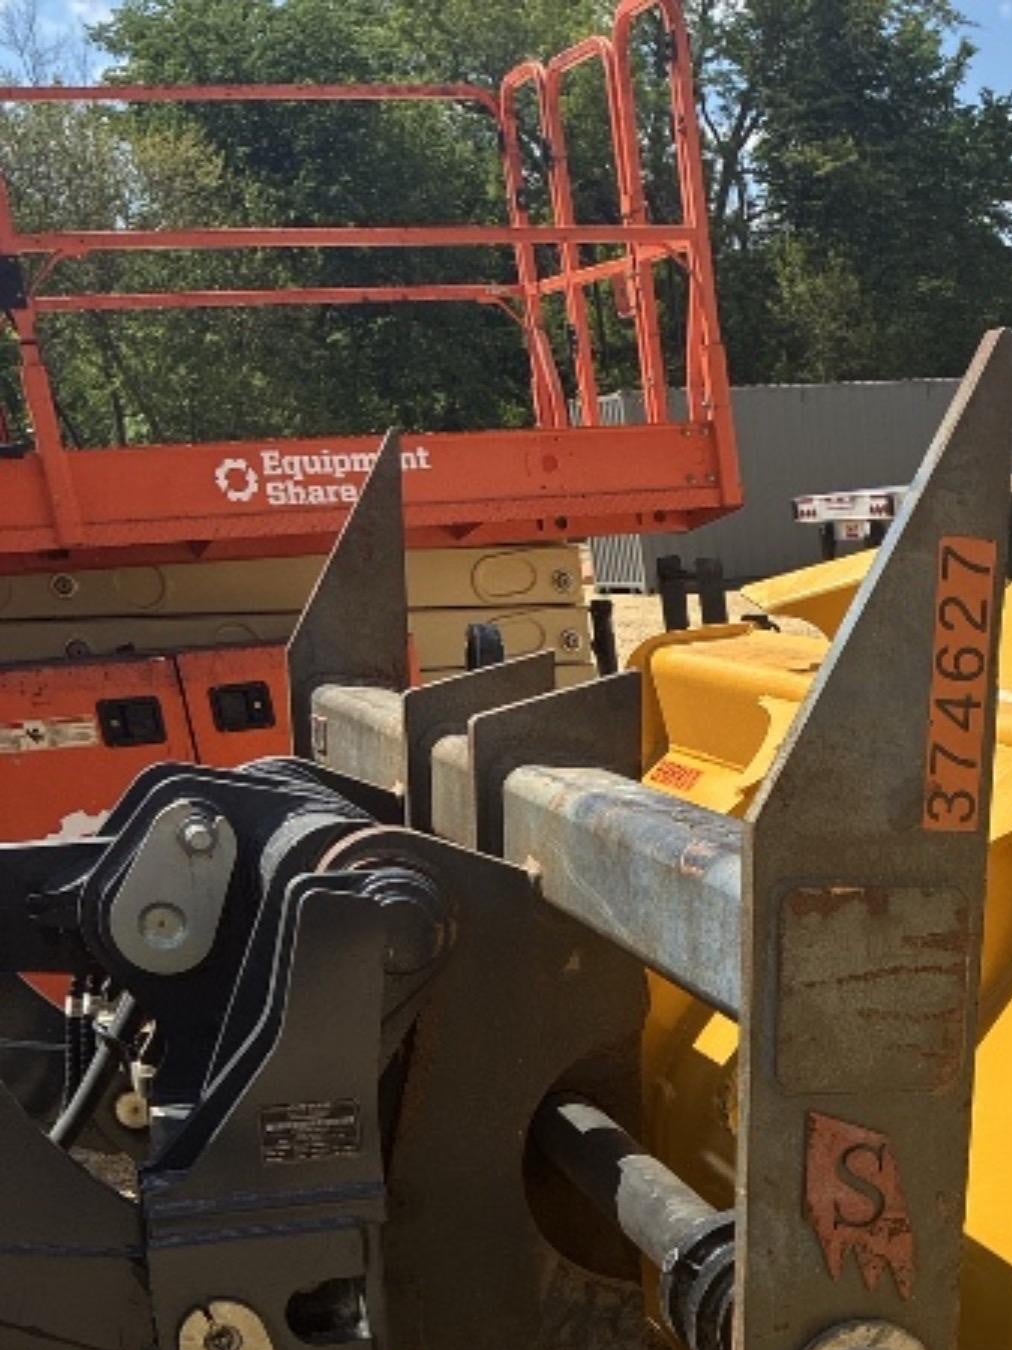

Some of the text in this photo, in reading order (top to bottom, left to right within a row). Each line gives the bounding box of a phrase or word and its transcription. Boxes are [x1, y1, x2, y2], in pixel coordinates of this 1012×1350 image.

[260, 446, 432, 480] Equipmnt
[265, 479, 359, 505] Share
[926, 545, 991, 823] 374627
